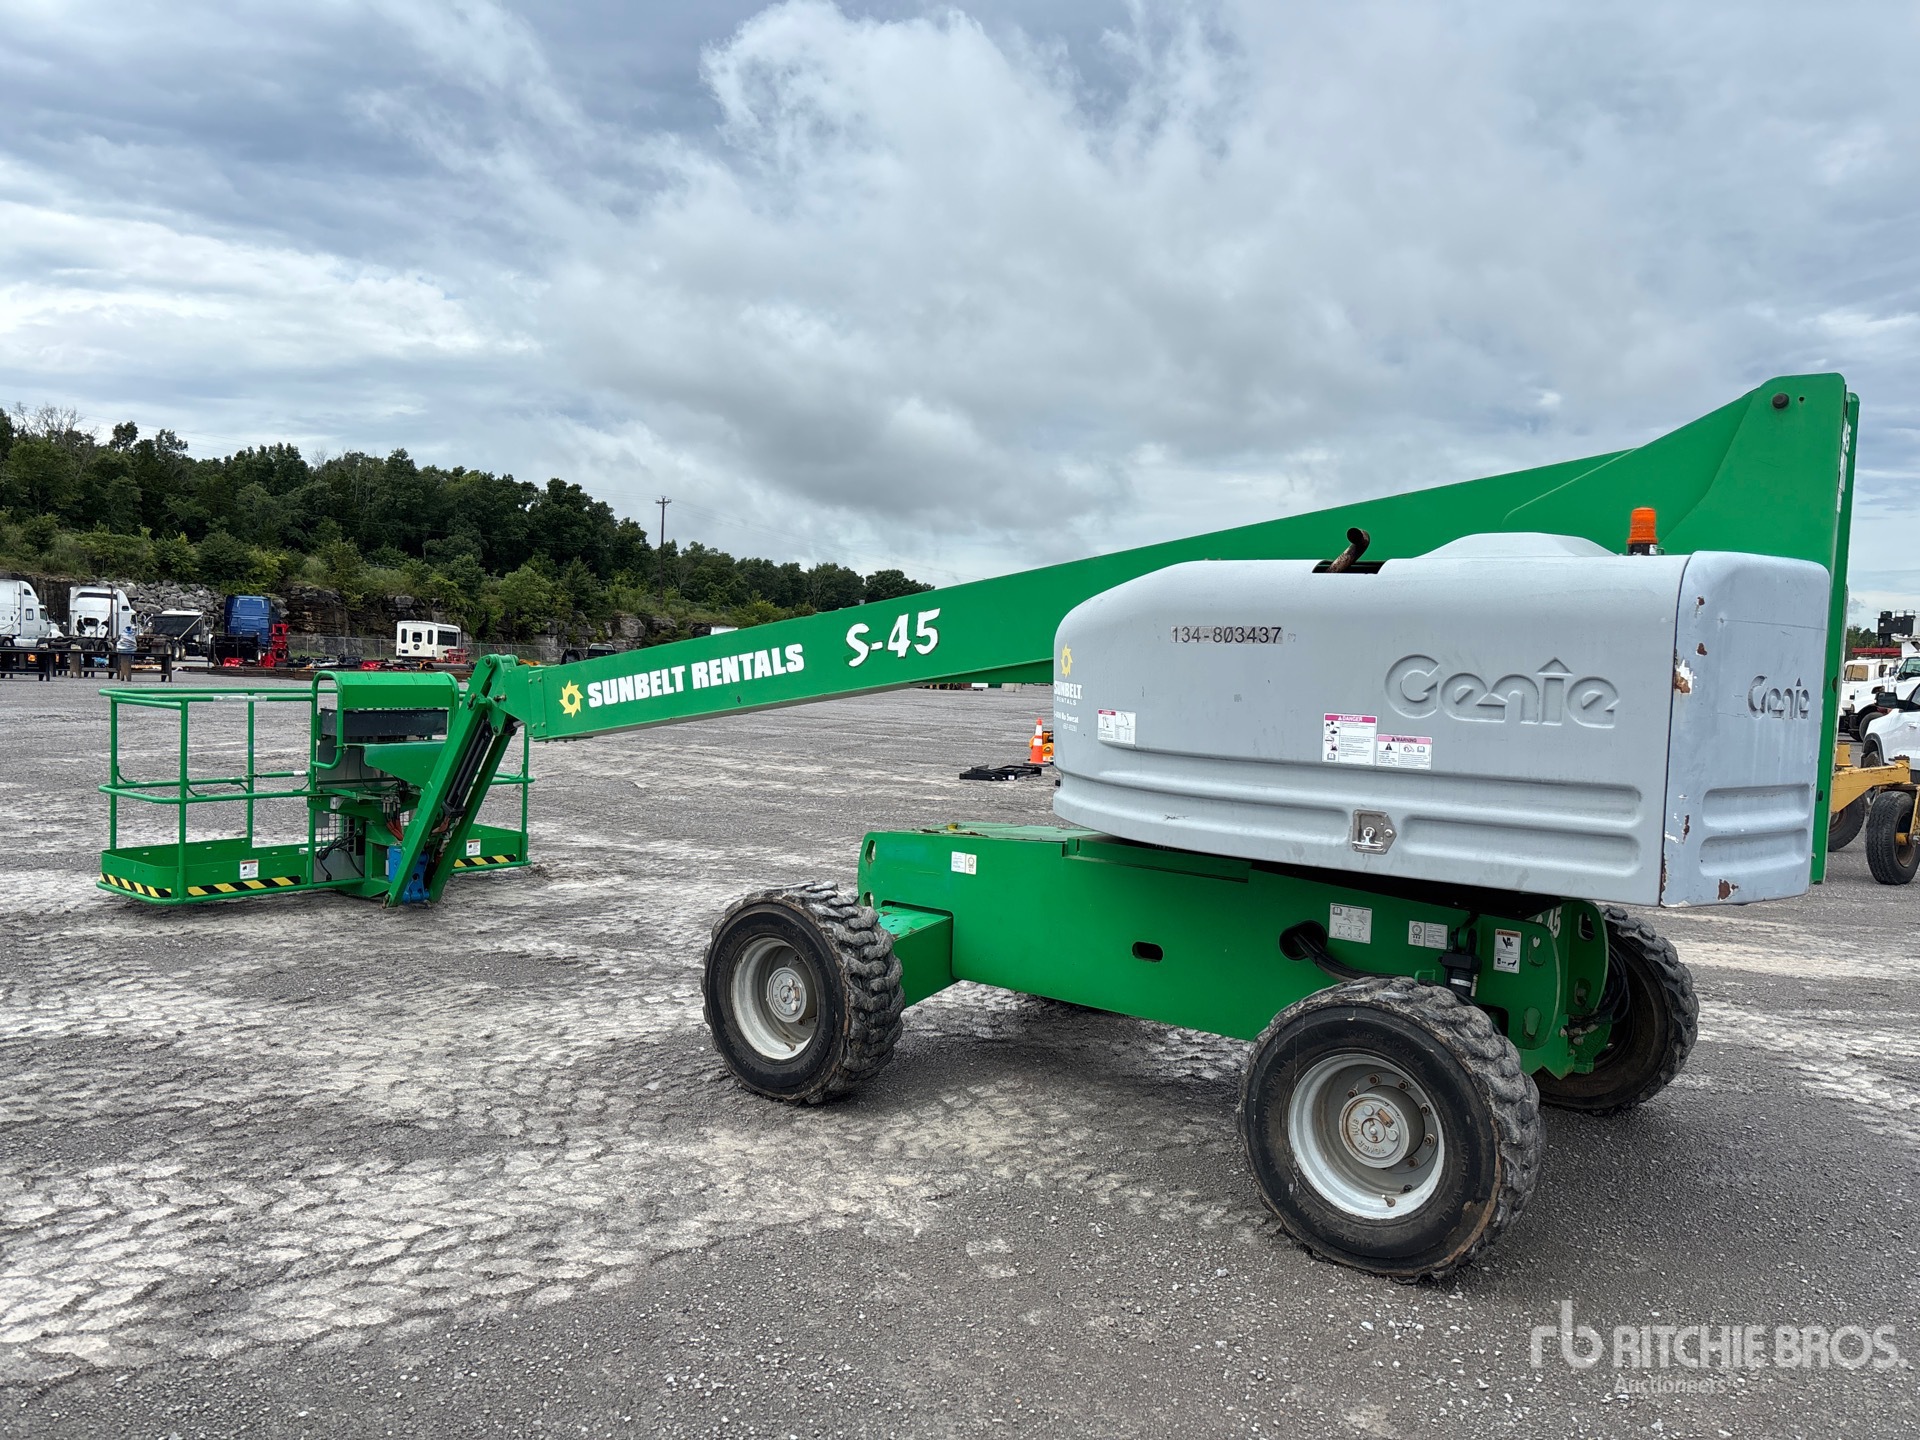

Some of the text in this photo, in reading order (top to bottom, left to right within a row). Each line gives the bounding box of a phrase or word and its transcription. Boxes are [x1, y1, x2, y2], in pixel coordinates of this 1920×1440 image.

[845, 607, 941, 668] S-45
[587, 643, 805, 708] SUNBELT RENTALS
[1384, 653, 1620, 729] Genie
